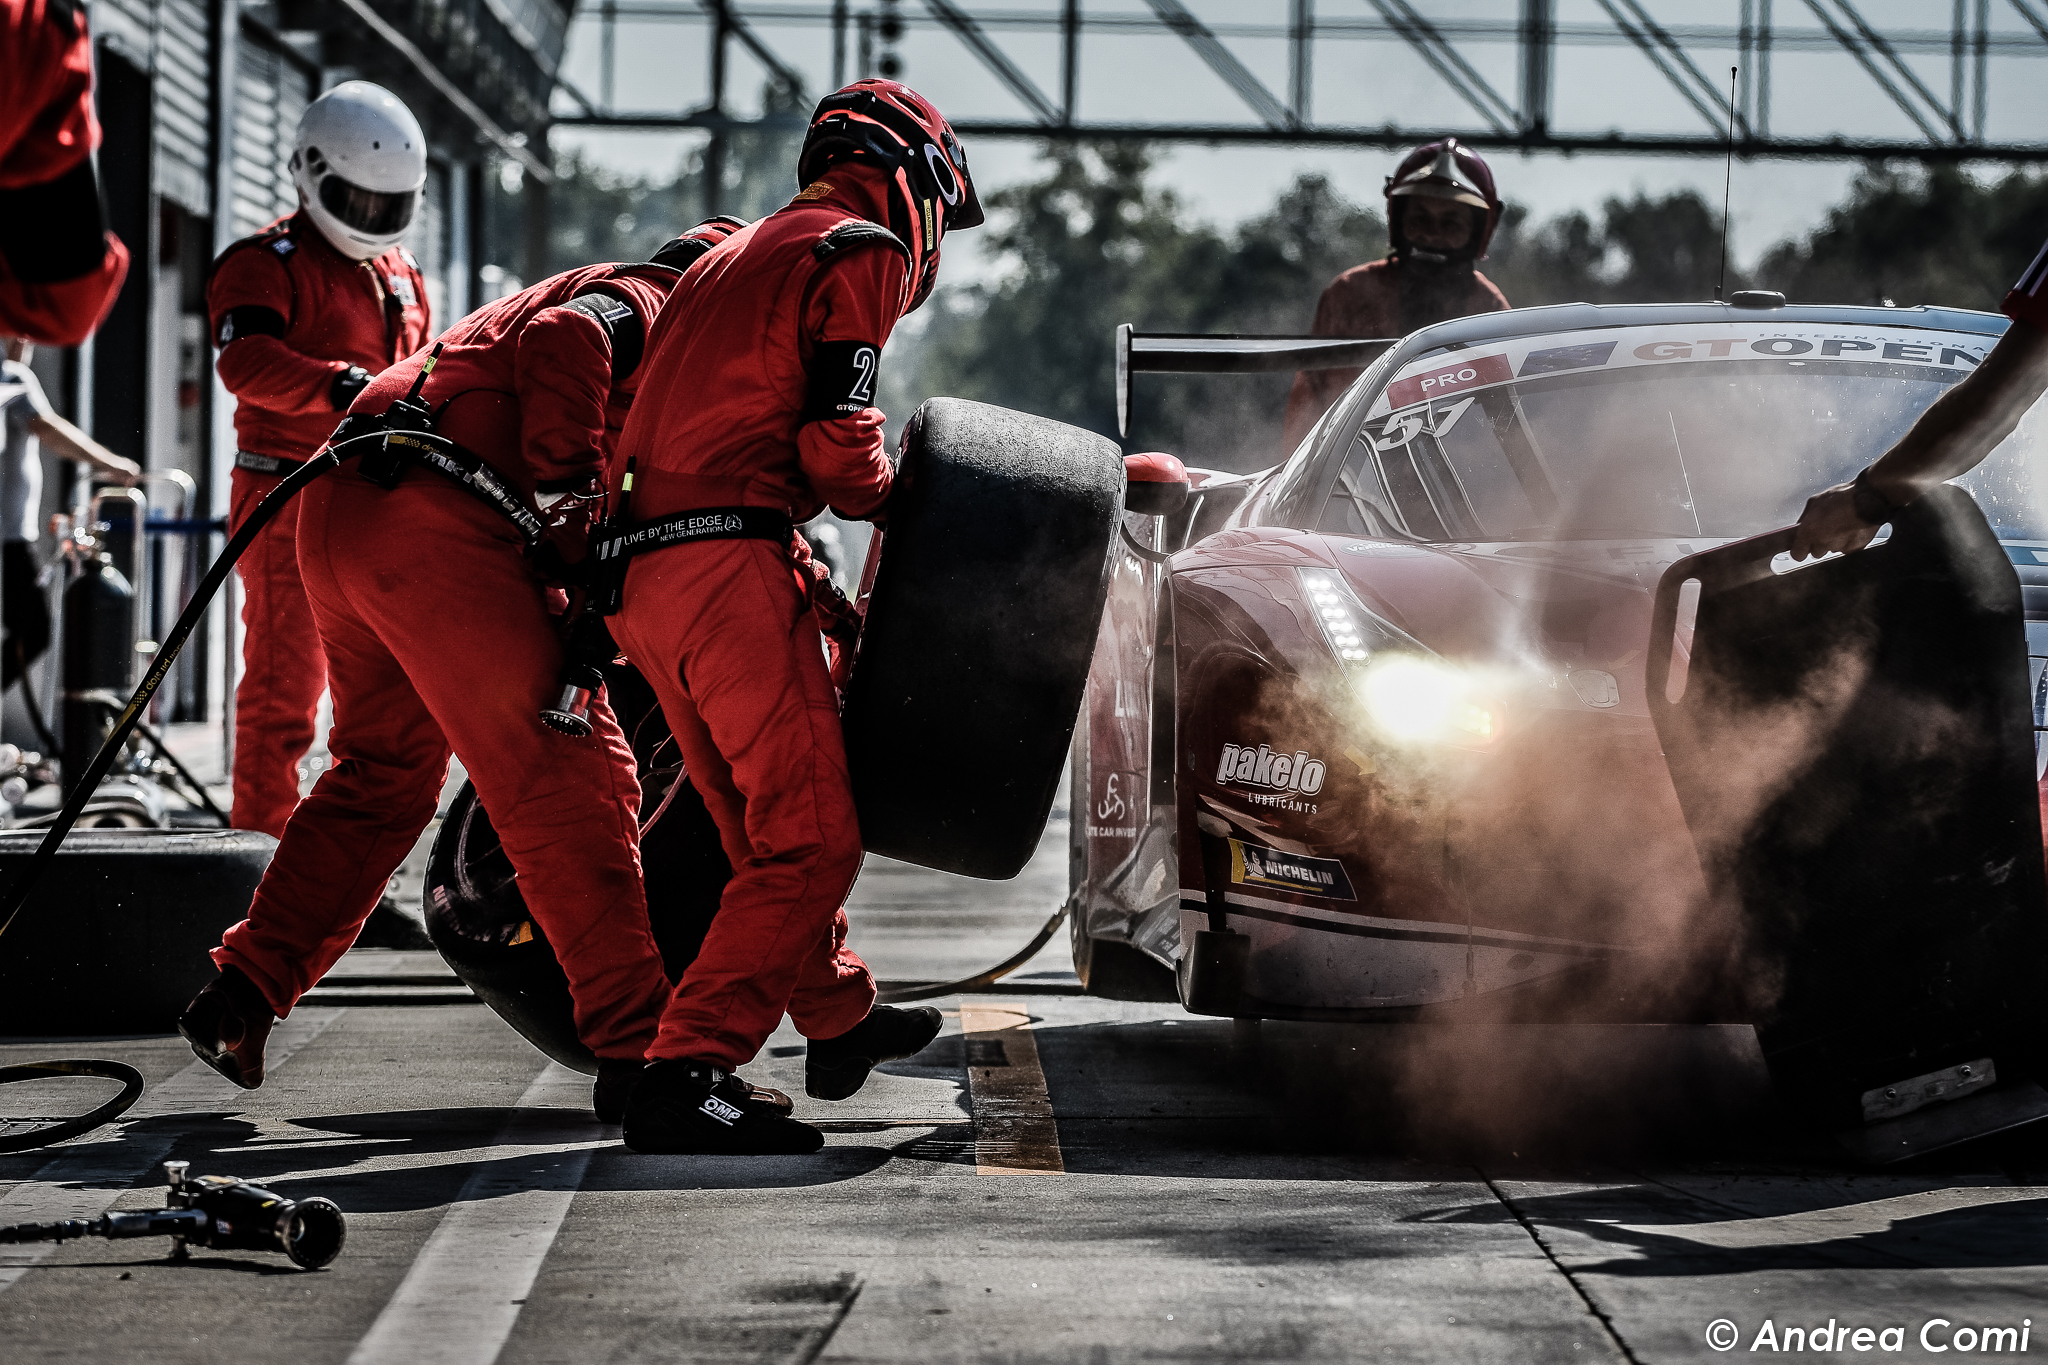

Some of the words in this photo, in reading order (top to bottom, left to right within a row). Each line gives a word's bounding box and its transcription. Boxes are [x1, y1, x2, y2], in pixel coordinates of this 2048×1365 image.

[1759, 333, 1986, 352] INTERNATIONA
[848, 347, 876, 402] 2
[1420, 368, 1477, 392] PRO
[623, 531, 646, 546] LIVE
[648, 526, 662, 539] BY
[664, 520, 686, 534] THE
[688, 514, 723, 529] EDGE
[660, 533, 675, 542] NEW
[676, 525, 724, 538] GENERATION
[1216, 743, 1327, 796] pakelo
[1248, 792, 1318, 814] LUBRICANTS
[1265, 860, 1334, 885] MICHELIN
[704, 1098, 741, 1120] OMP
